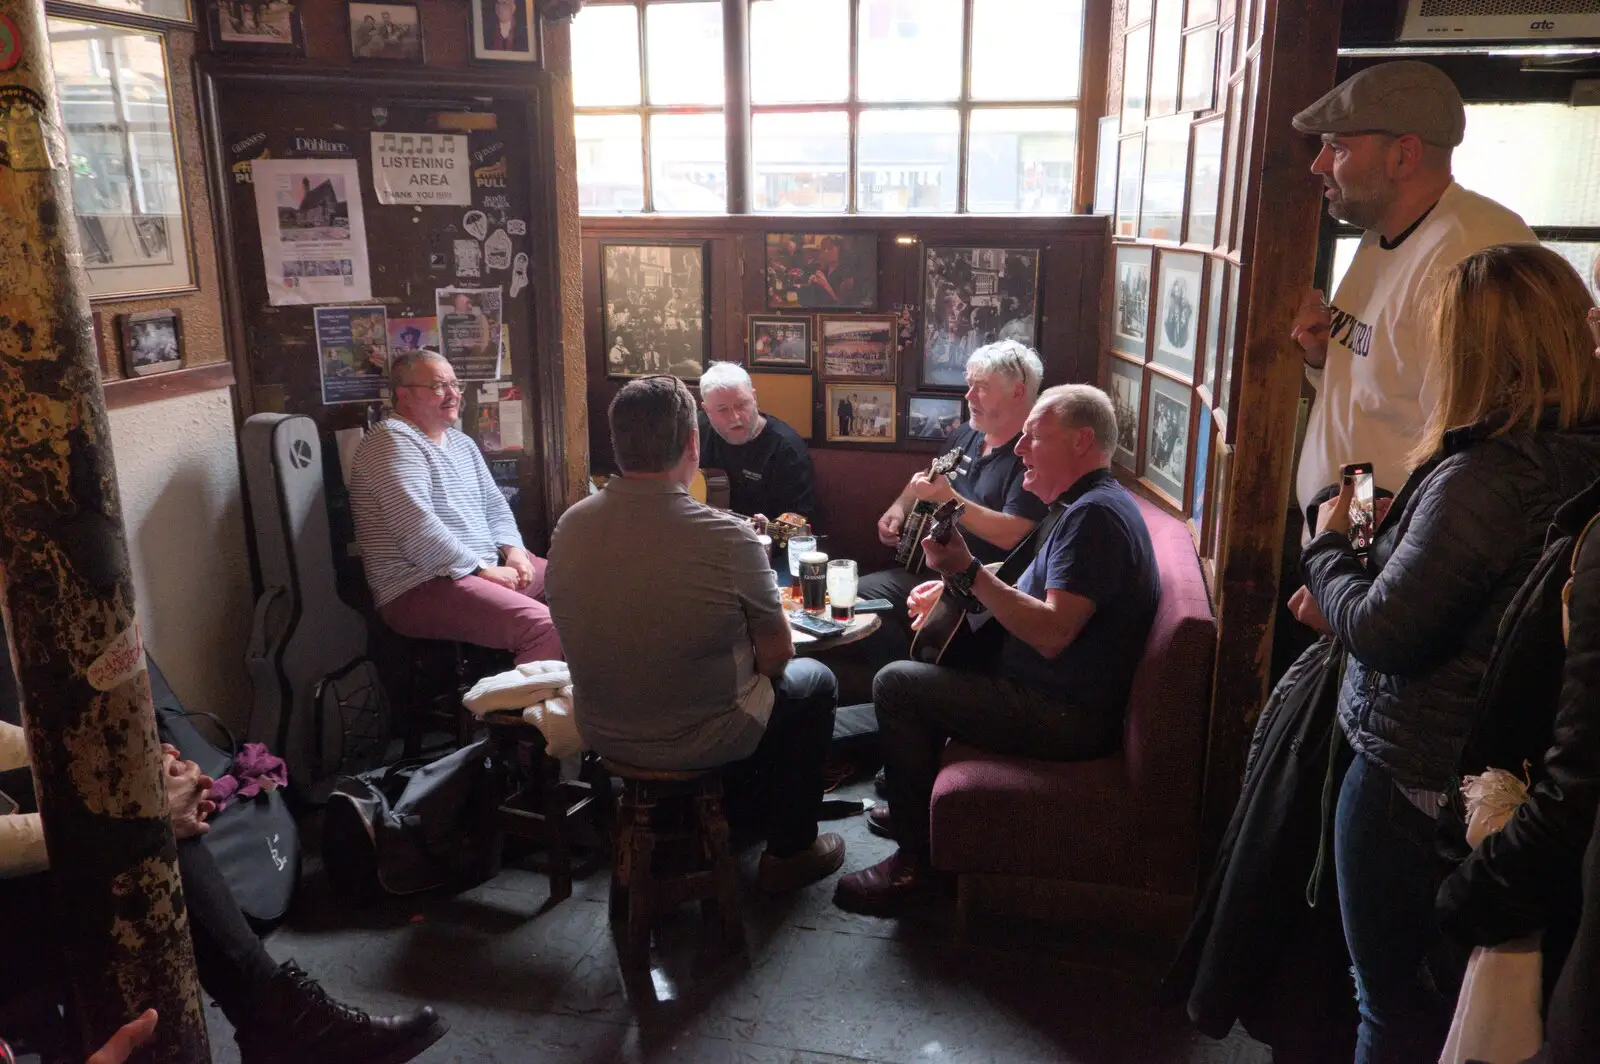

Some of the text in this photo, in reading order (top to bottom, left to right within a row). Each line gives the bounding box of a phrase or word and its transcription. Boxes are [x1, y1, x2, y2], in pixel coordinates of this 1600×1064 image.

[381, 156, 455, 170] LISTENING
[409, 174, 449, 186] AREA
[477, 178, 507, 188] PULL
[417, 191, 434, 199] YOU
